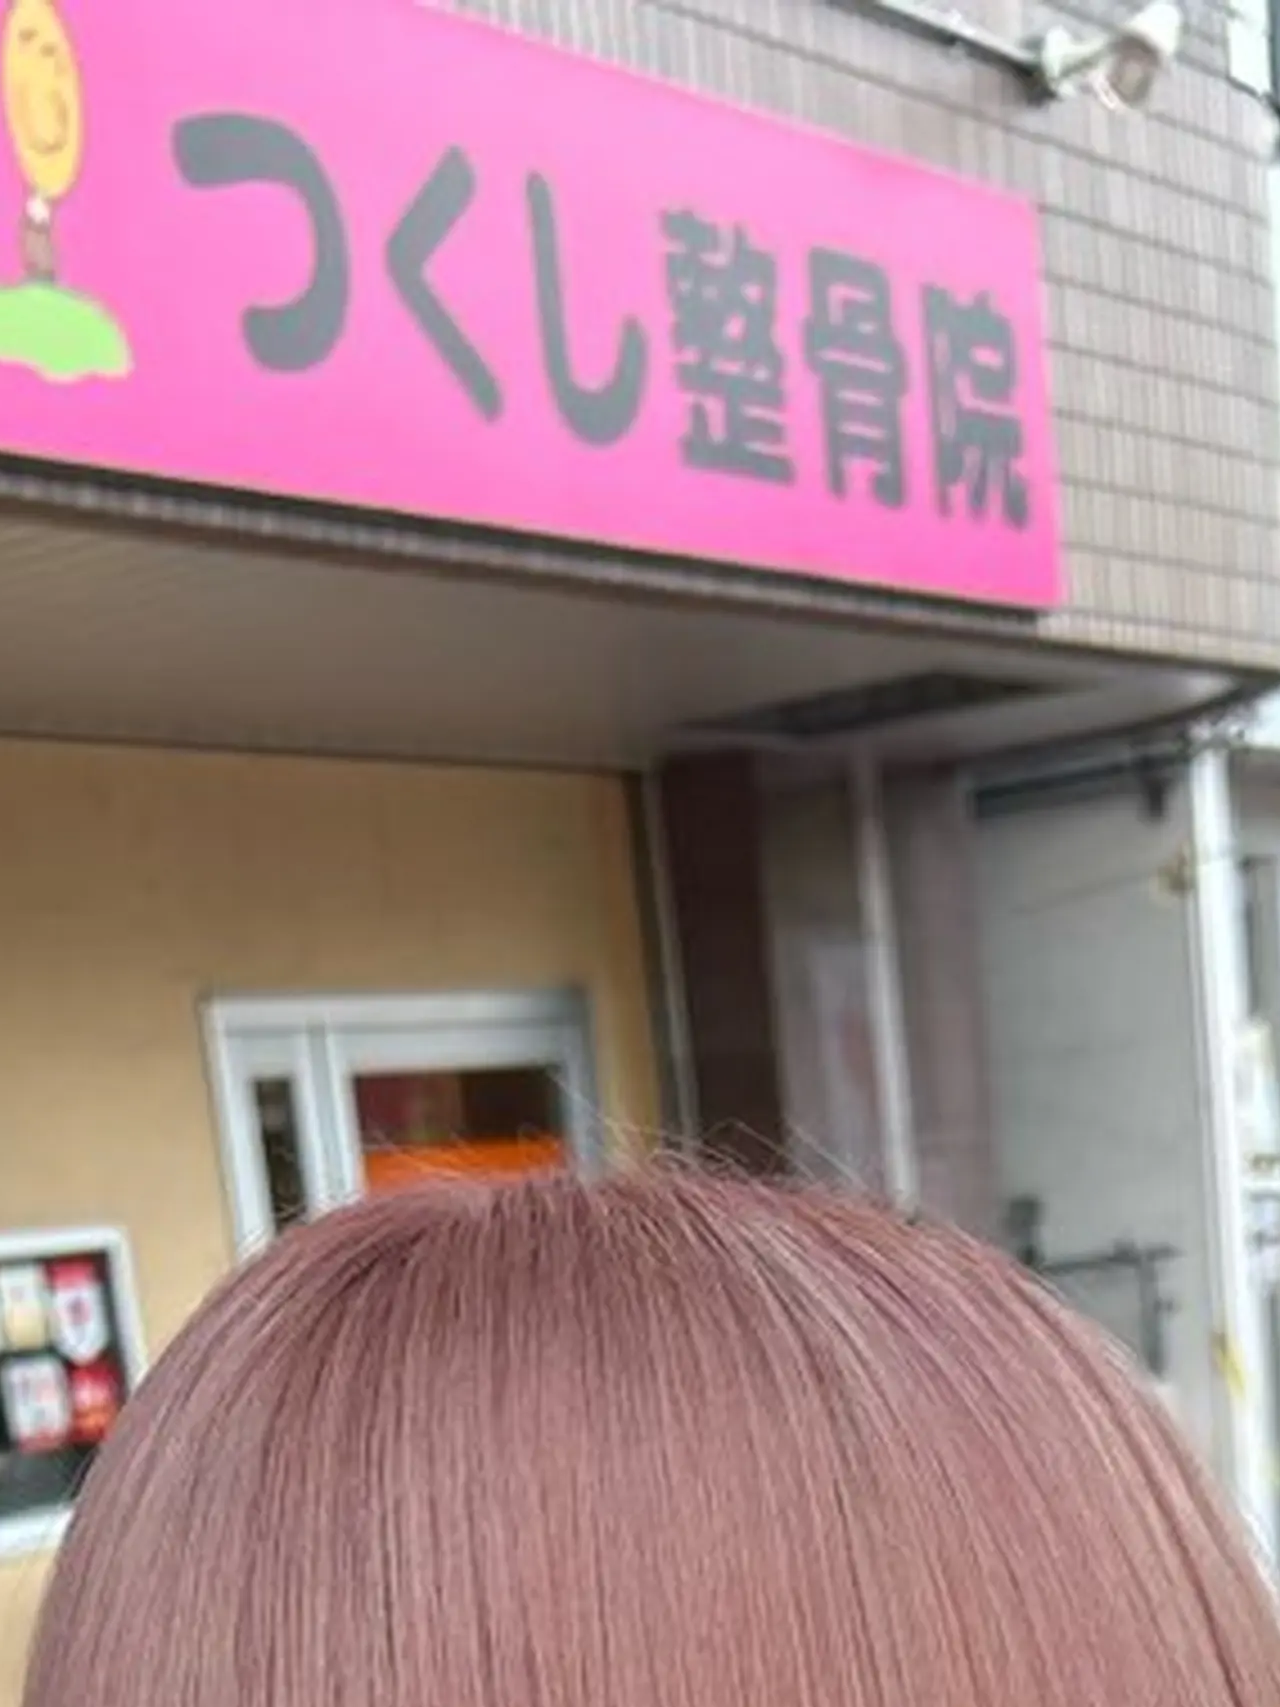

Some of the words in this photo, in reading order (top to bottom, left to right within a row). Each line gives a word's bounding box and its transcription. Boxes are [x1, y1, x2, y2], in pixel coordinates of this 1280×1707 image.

[171, 110, 1029, 532] つくし整骨院
